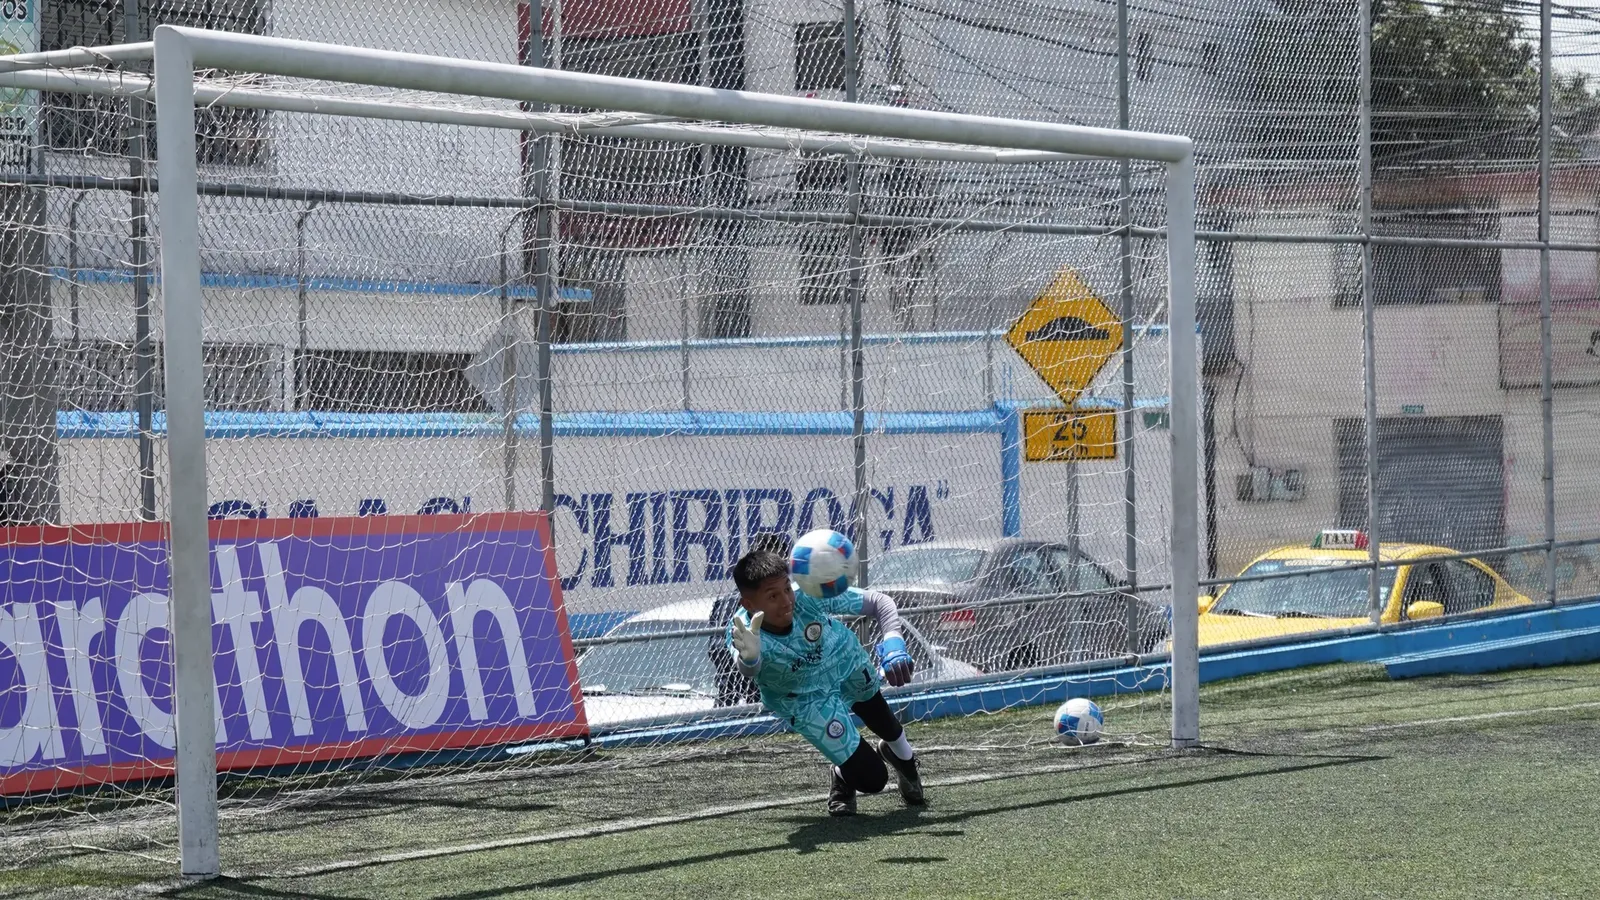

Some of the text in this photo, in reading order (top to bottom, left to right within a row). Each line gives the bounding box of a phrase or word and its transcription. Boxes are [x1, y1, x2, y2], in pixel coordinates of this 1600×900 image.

[1053, 414, 1088, 441] 25
[1324, 533, 1354, 545] TAXI
[862, 667, 872, 684] 1
